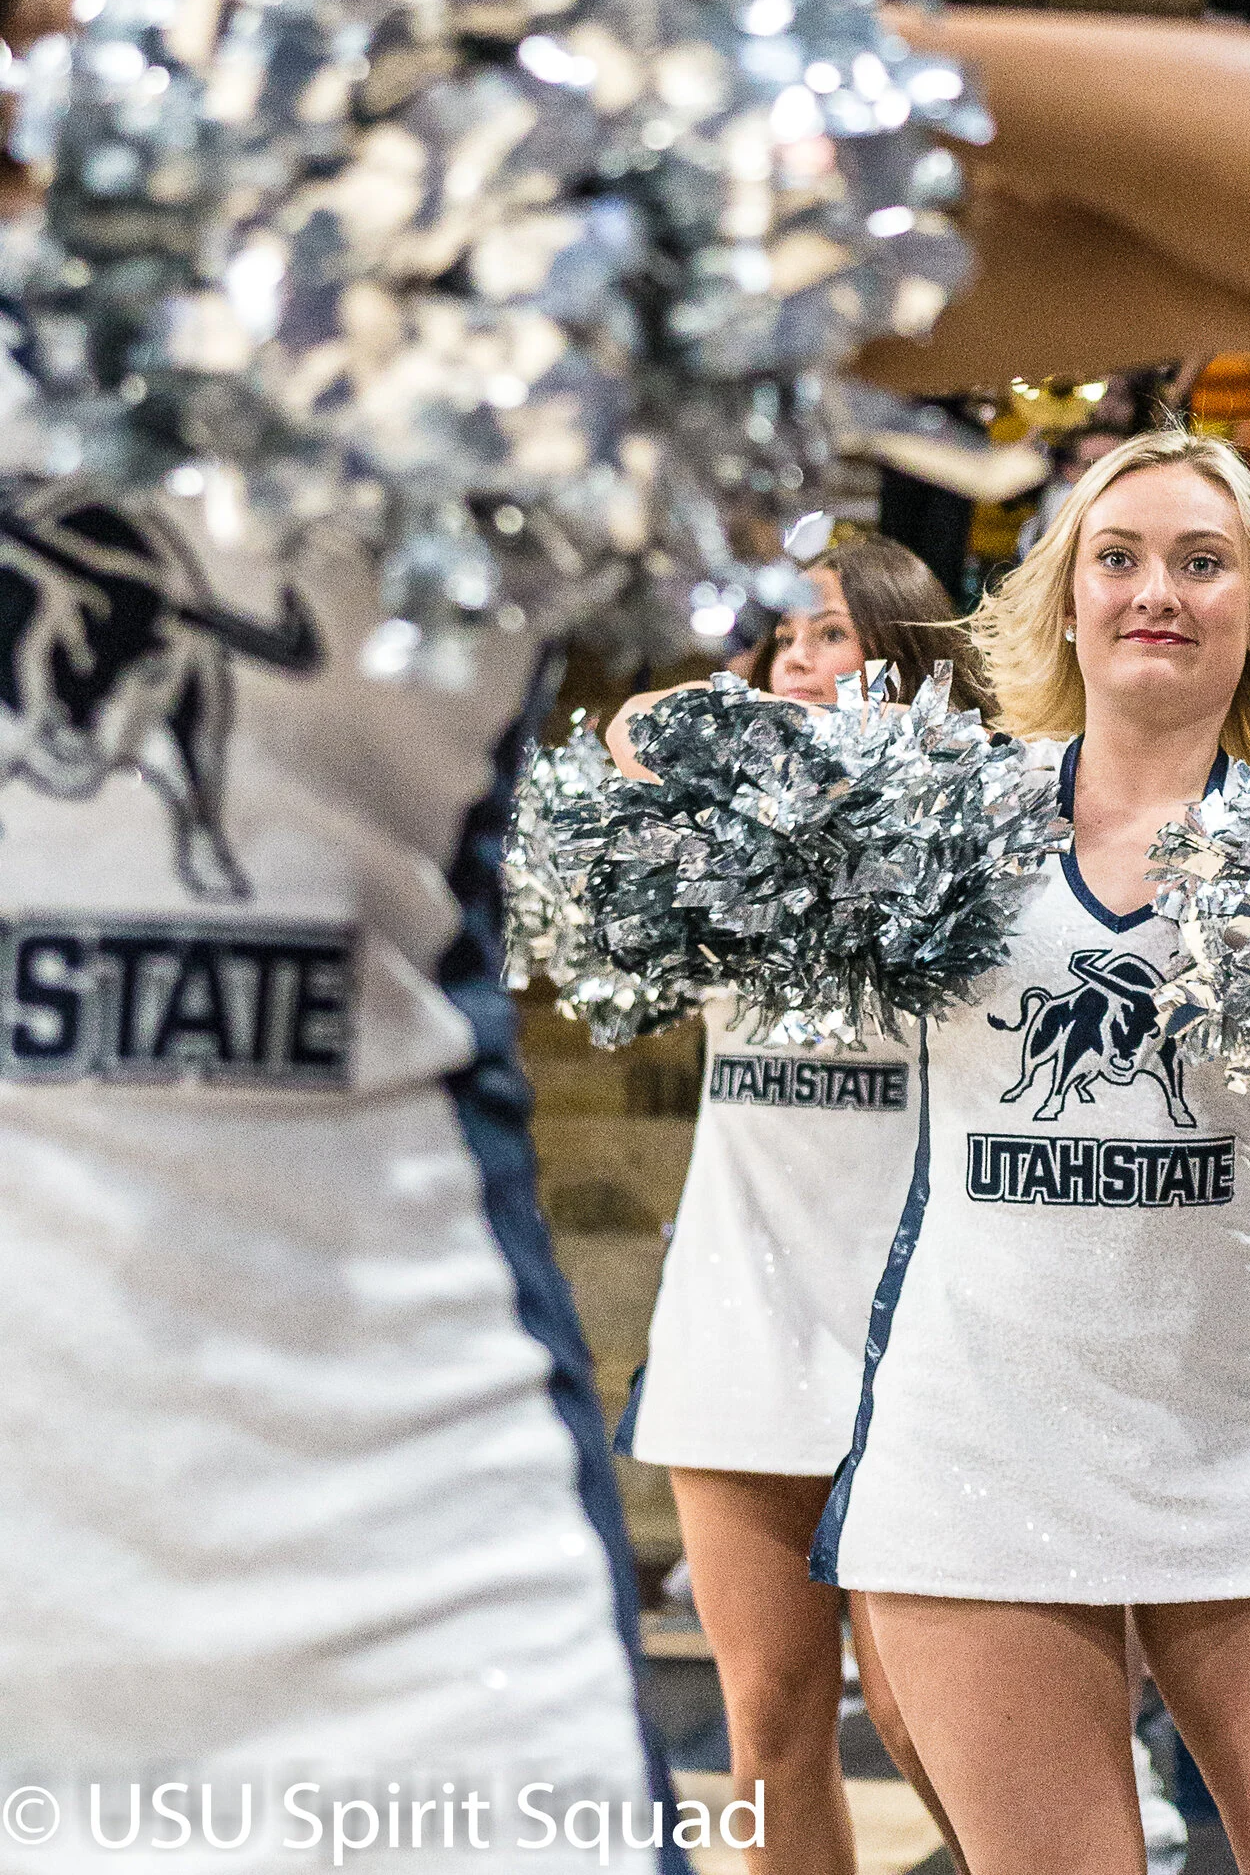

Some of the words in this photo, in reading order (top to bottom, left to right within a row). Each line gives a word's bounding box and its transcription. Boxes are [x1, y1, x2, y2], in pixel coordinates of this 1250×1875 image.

[8, 920, 352, 1075] STATE
[793, 1059, 909, 1111] STATE
[967, 1133, 1099, 1205] UTAH
[1099, 1136, 1235, 1207] STATE
